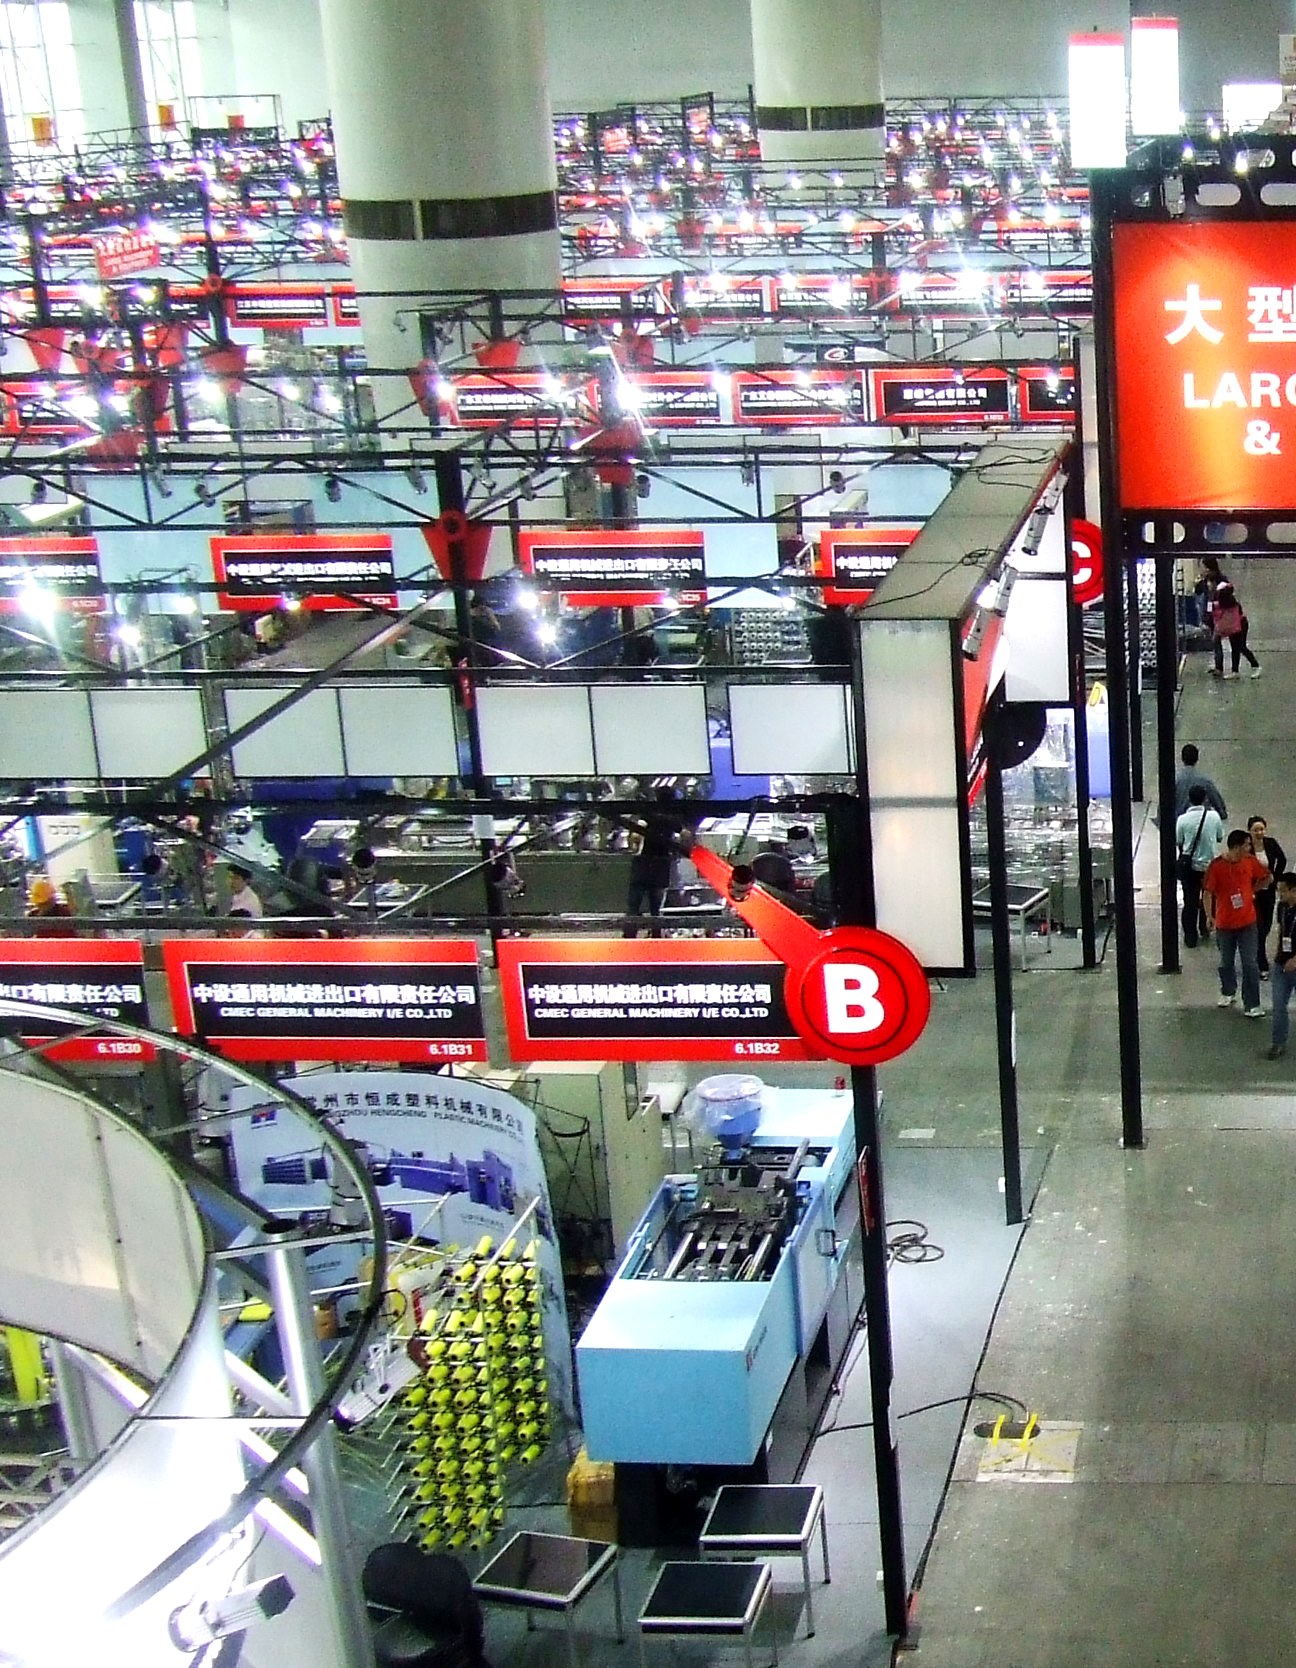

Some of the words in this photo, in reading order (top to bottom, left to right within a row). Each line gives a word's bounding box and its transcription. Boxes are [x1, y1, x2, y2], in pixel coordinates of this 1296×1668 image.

[1243, 419, 1282, 456] &
[1071, 541, 1092, 585] C
[192, 983, 477, 1005] 中设通用机械进出口有限责任公司
[527, 983, 772, 1005] 中设通用机械进出口有限责任公司
[822, 963, 886, 1035] B
[221, 1007, 255, 1019] CMEC
[256, 1007, 311, 1019] GENERAL
[313, 1007, 384, 1019] MACHINERY
[534, 1007, 569, 1019] CMEC
[571, 1007, 627, 1019] GENERAL
[628, 1007, 699, 1019] MACHINERY
[428, 1043, 473, 1056] 6.1B31
[734, 1042, 780, 1055] 6.1B32
